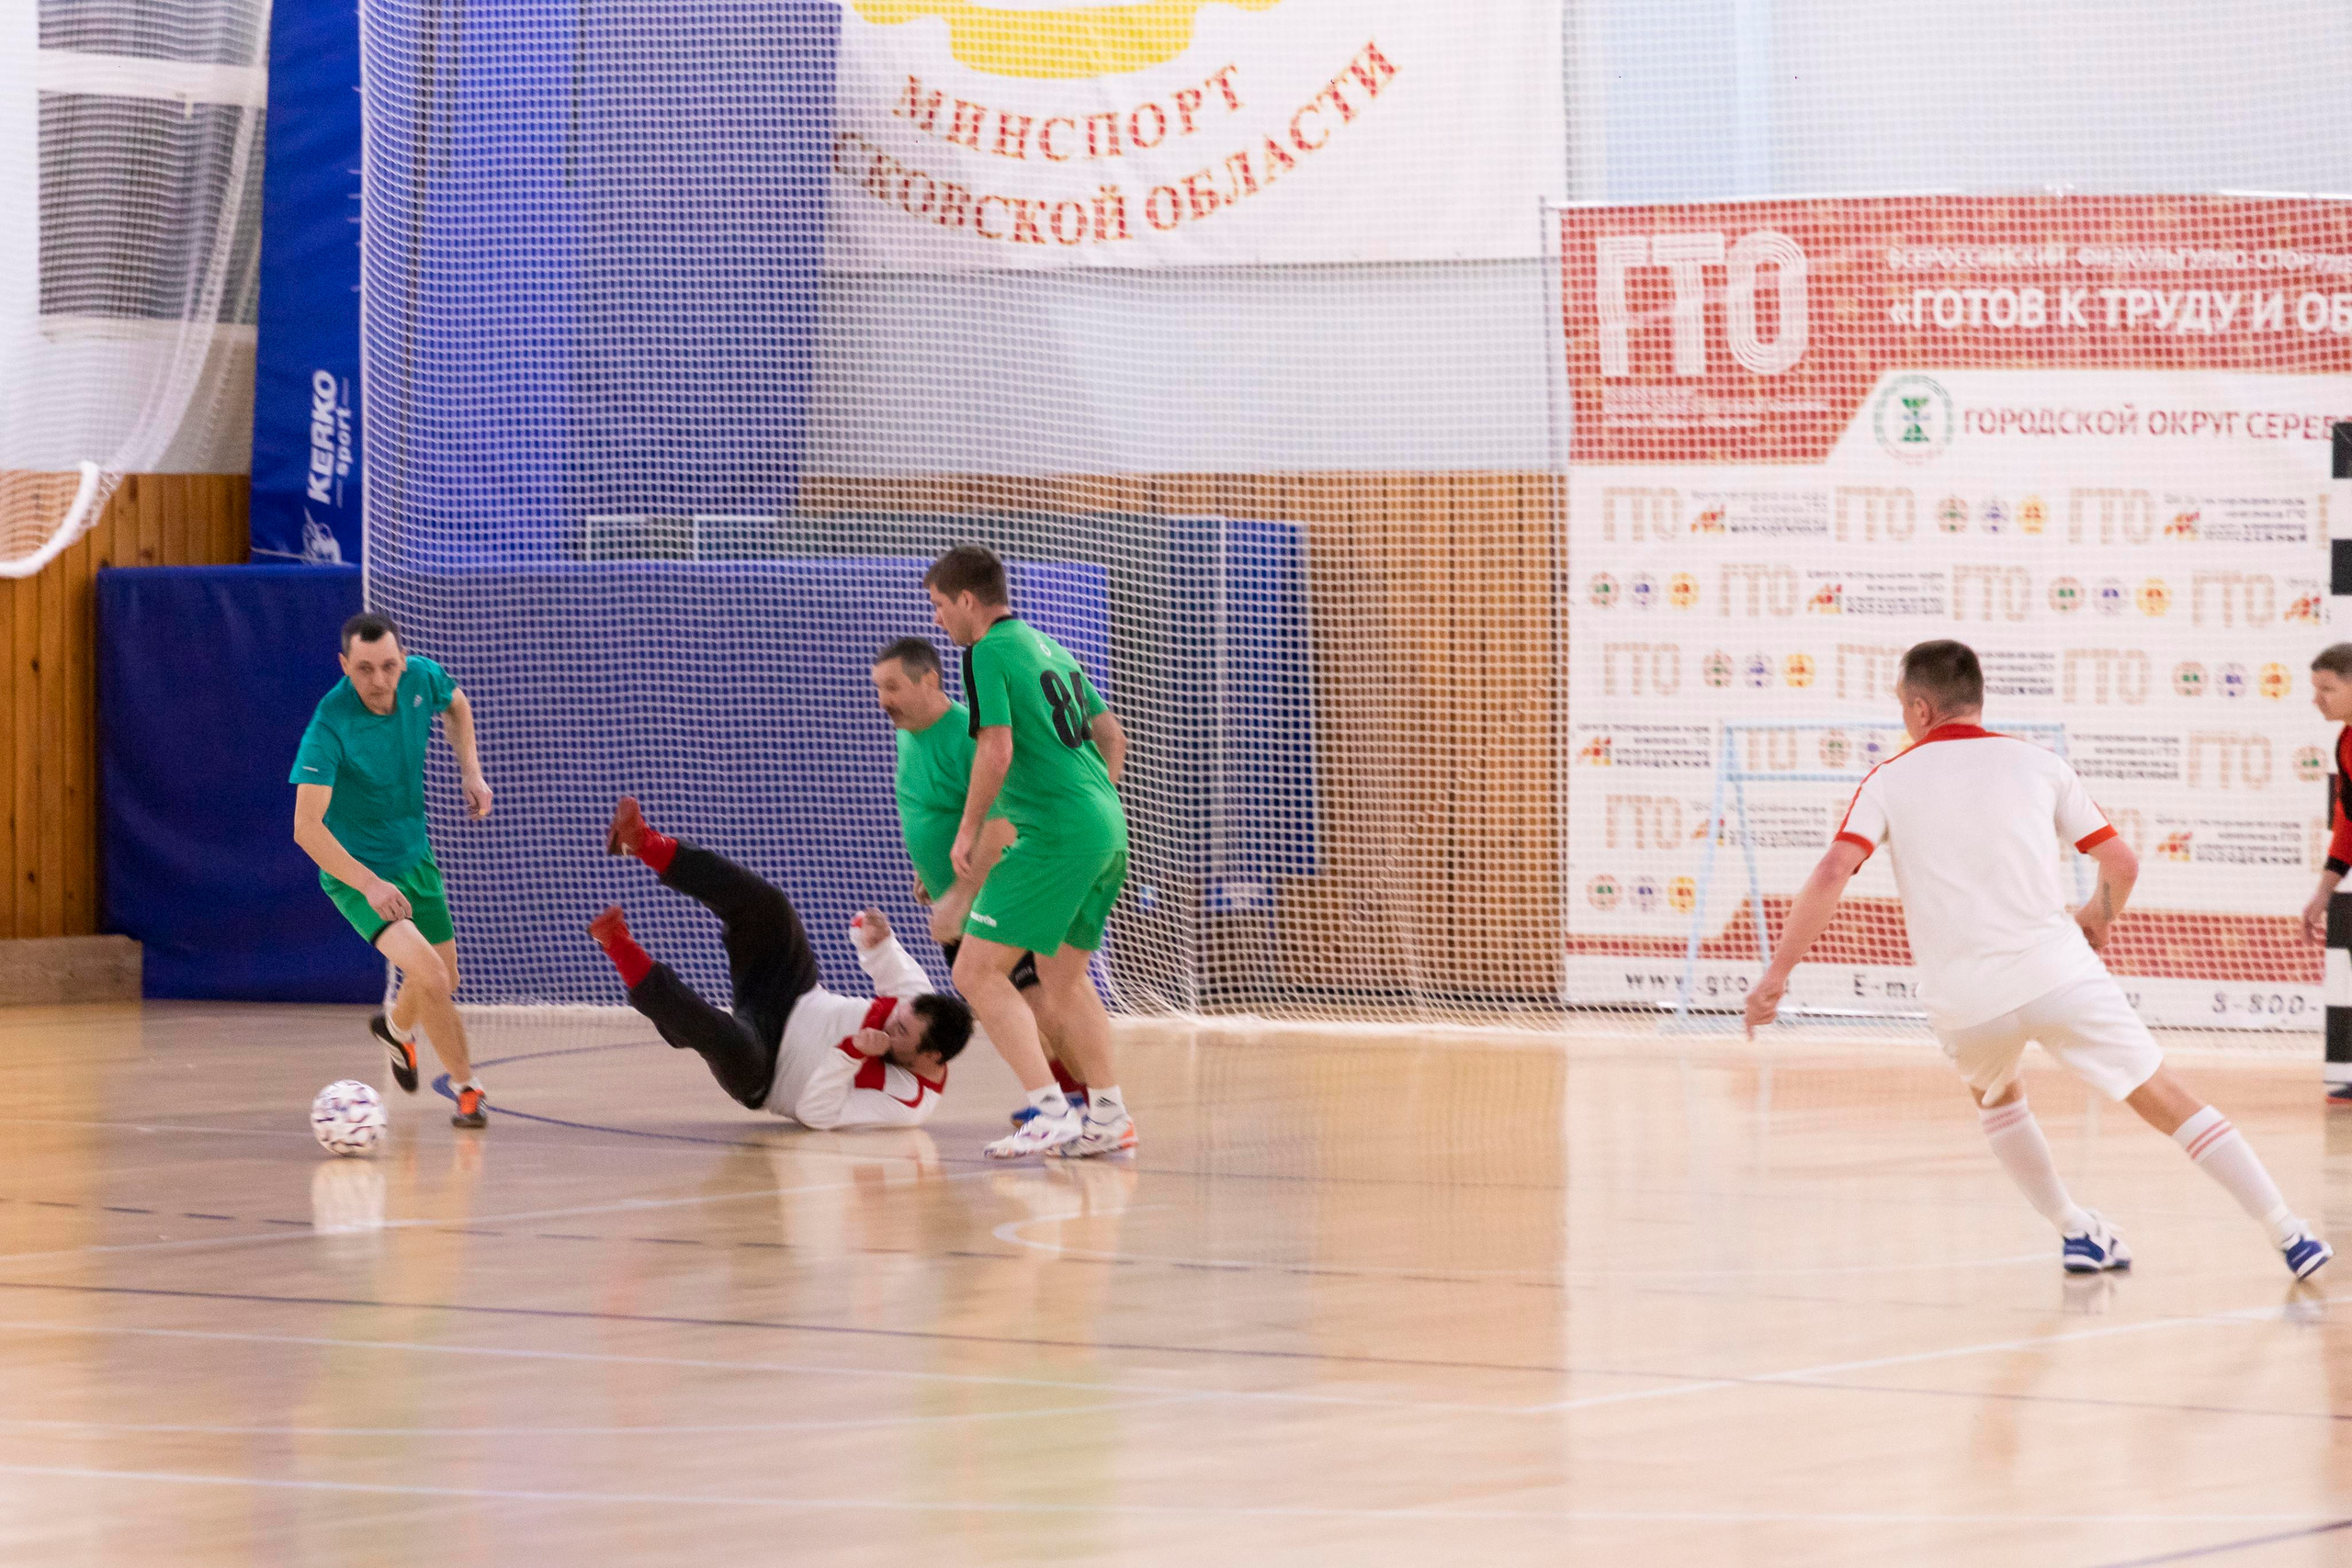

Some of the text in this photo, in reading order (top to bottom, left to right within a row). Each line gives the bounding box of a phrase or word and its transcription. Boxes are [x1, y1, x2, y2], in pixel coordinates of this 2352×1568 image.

[892, 63, 1244, 162] МИНСПОРТ
[1145, 40, 1401, 231] ОБЛАСТИ
[1596, 231, 1808, 378] ГТО
[1890, 289, 2046, 329] «ГОТОВ
[2060, 289, 2089, 327] К
[2101, 290, 2238, 335] ТРУДУ
[2253, 290, 2284, 331] И
[307, 369, 337, 504] KERKO
[335, 407, 353, 477] sport
[1963, 403, 2352, 440] ГОРОДСКОЙ ОКРУГ СЕРЕБ
